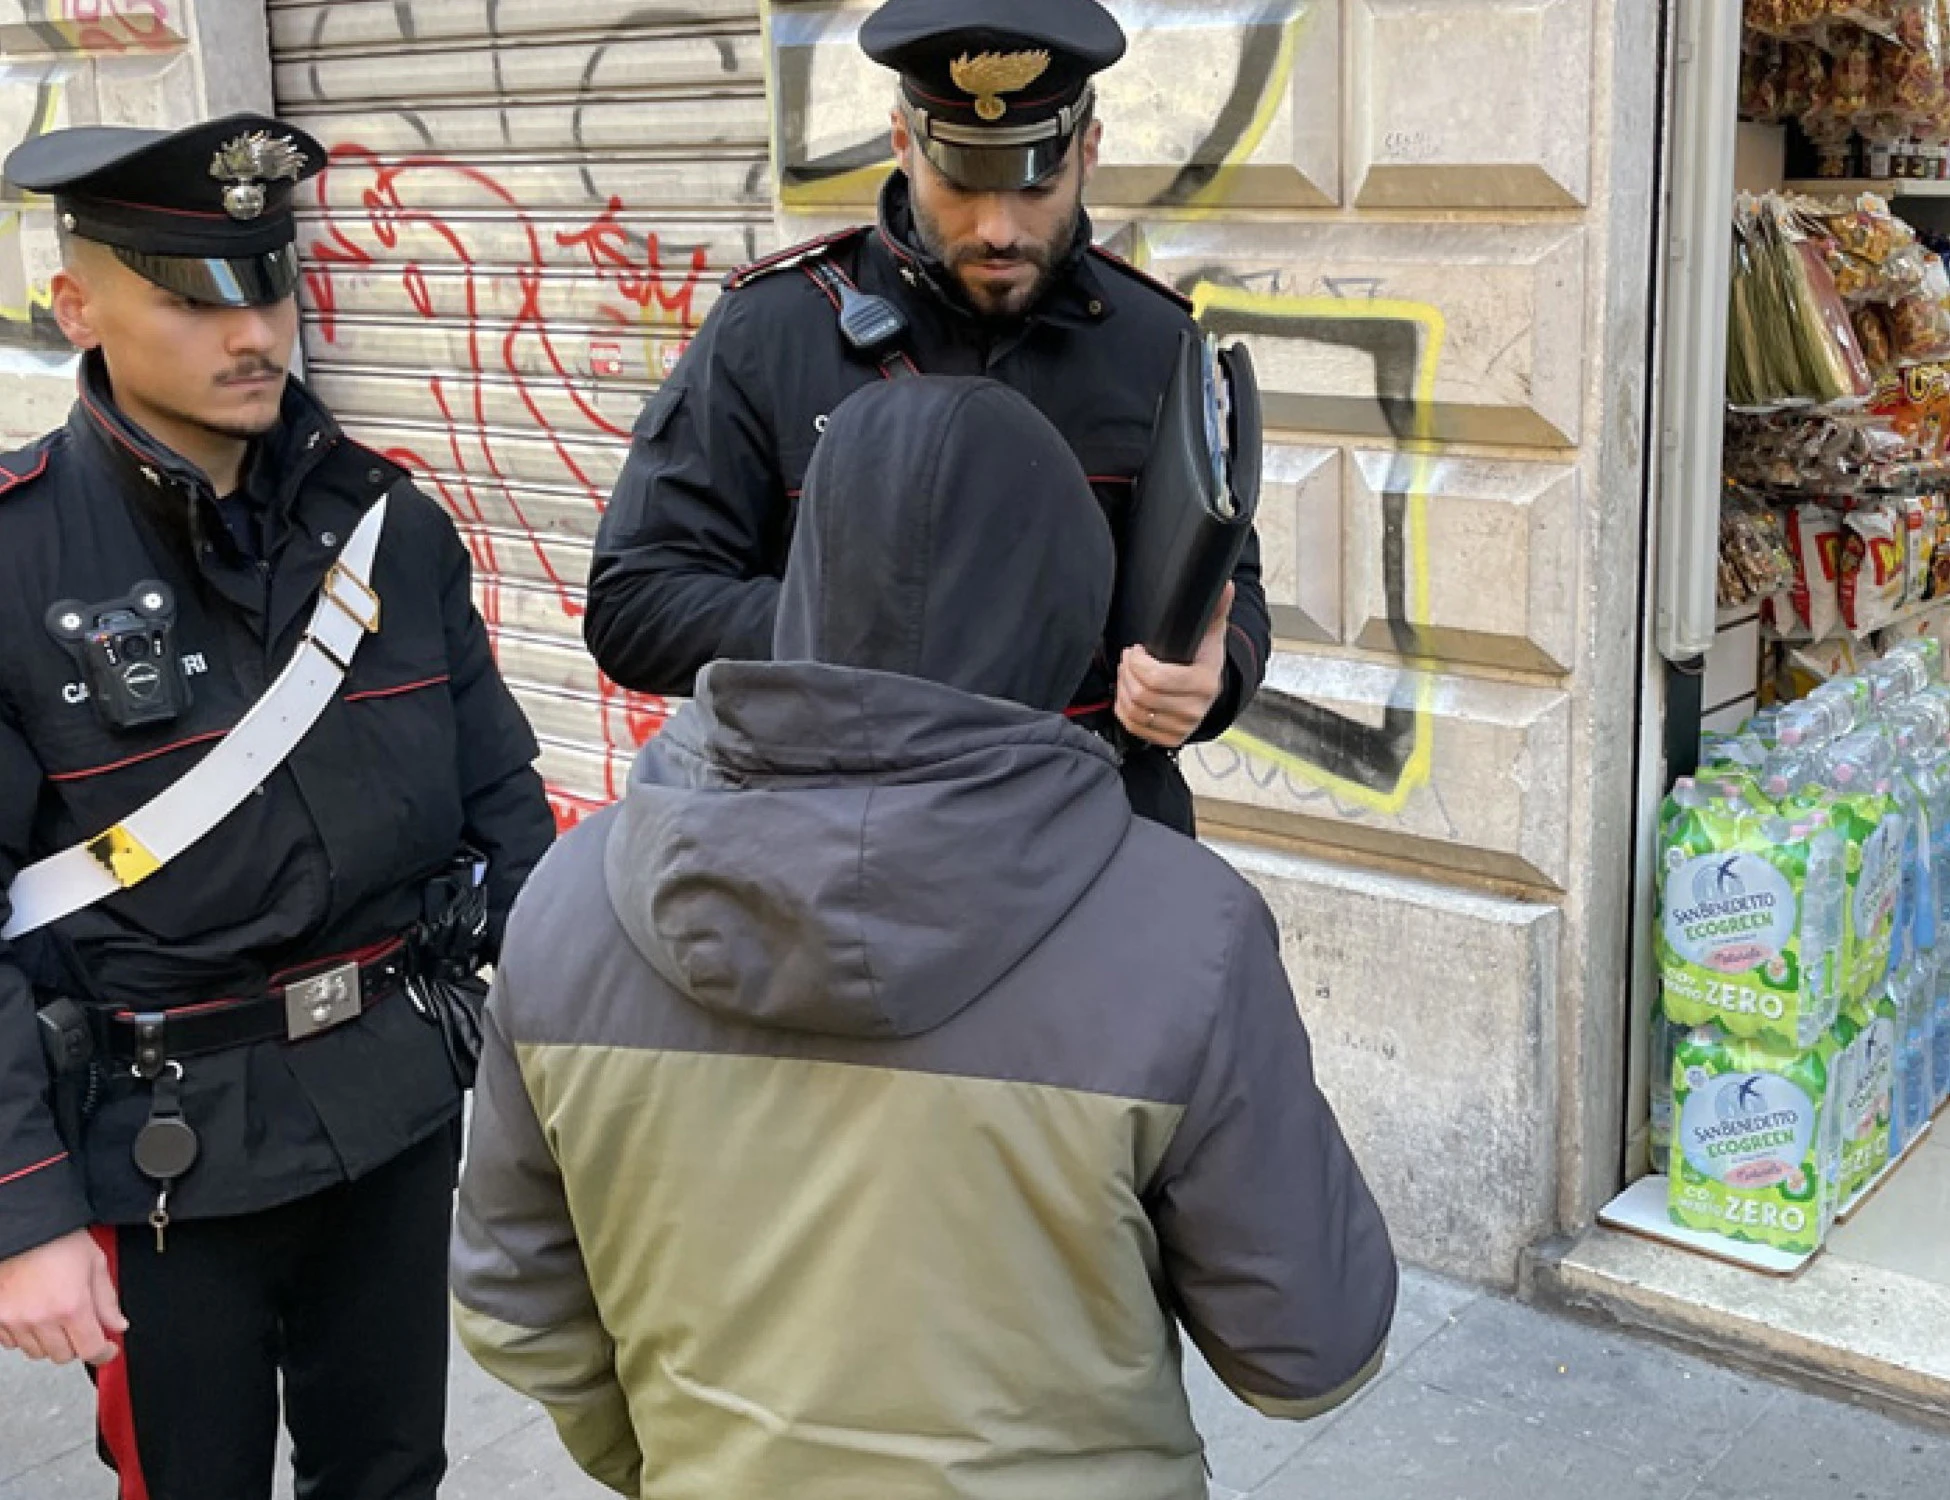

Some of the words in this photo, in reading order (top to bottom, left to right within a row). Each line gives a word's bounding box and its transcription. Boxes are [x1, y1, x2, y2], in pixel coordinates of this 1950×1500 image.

[1683, 911, 1774, 941] ECOGREEN
[1705, 980, 1783, 1020] ZERO
[1706, 1129, 1795, 1158] ECOGREEN
[1725, 1195, 1805, 1232] ZERO
